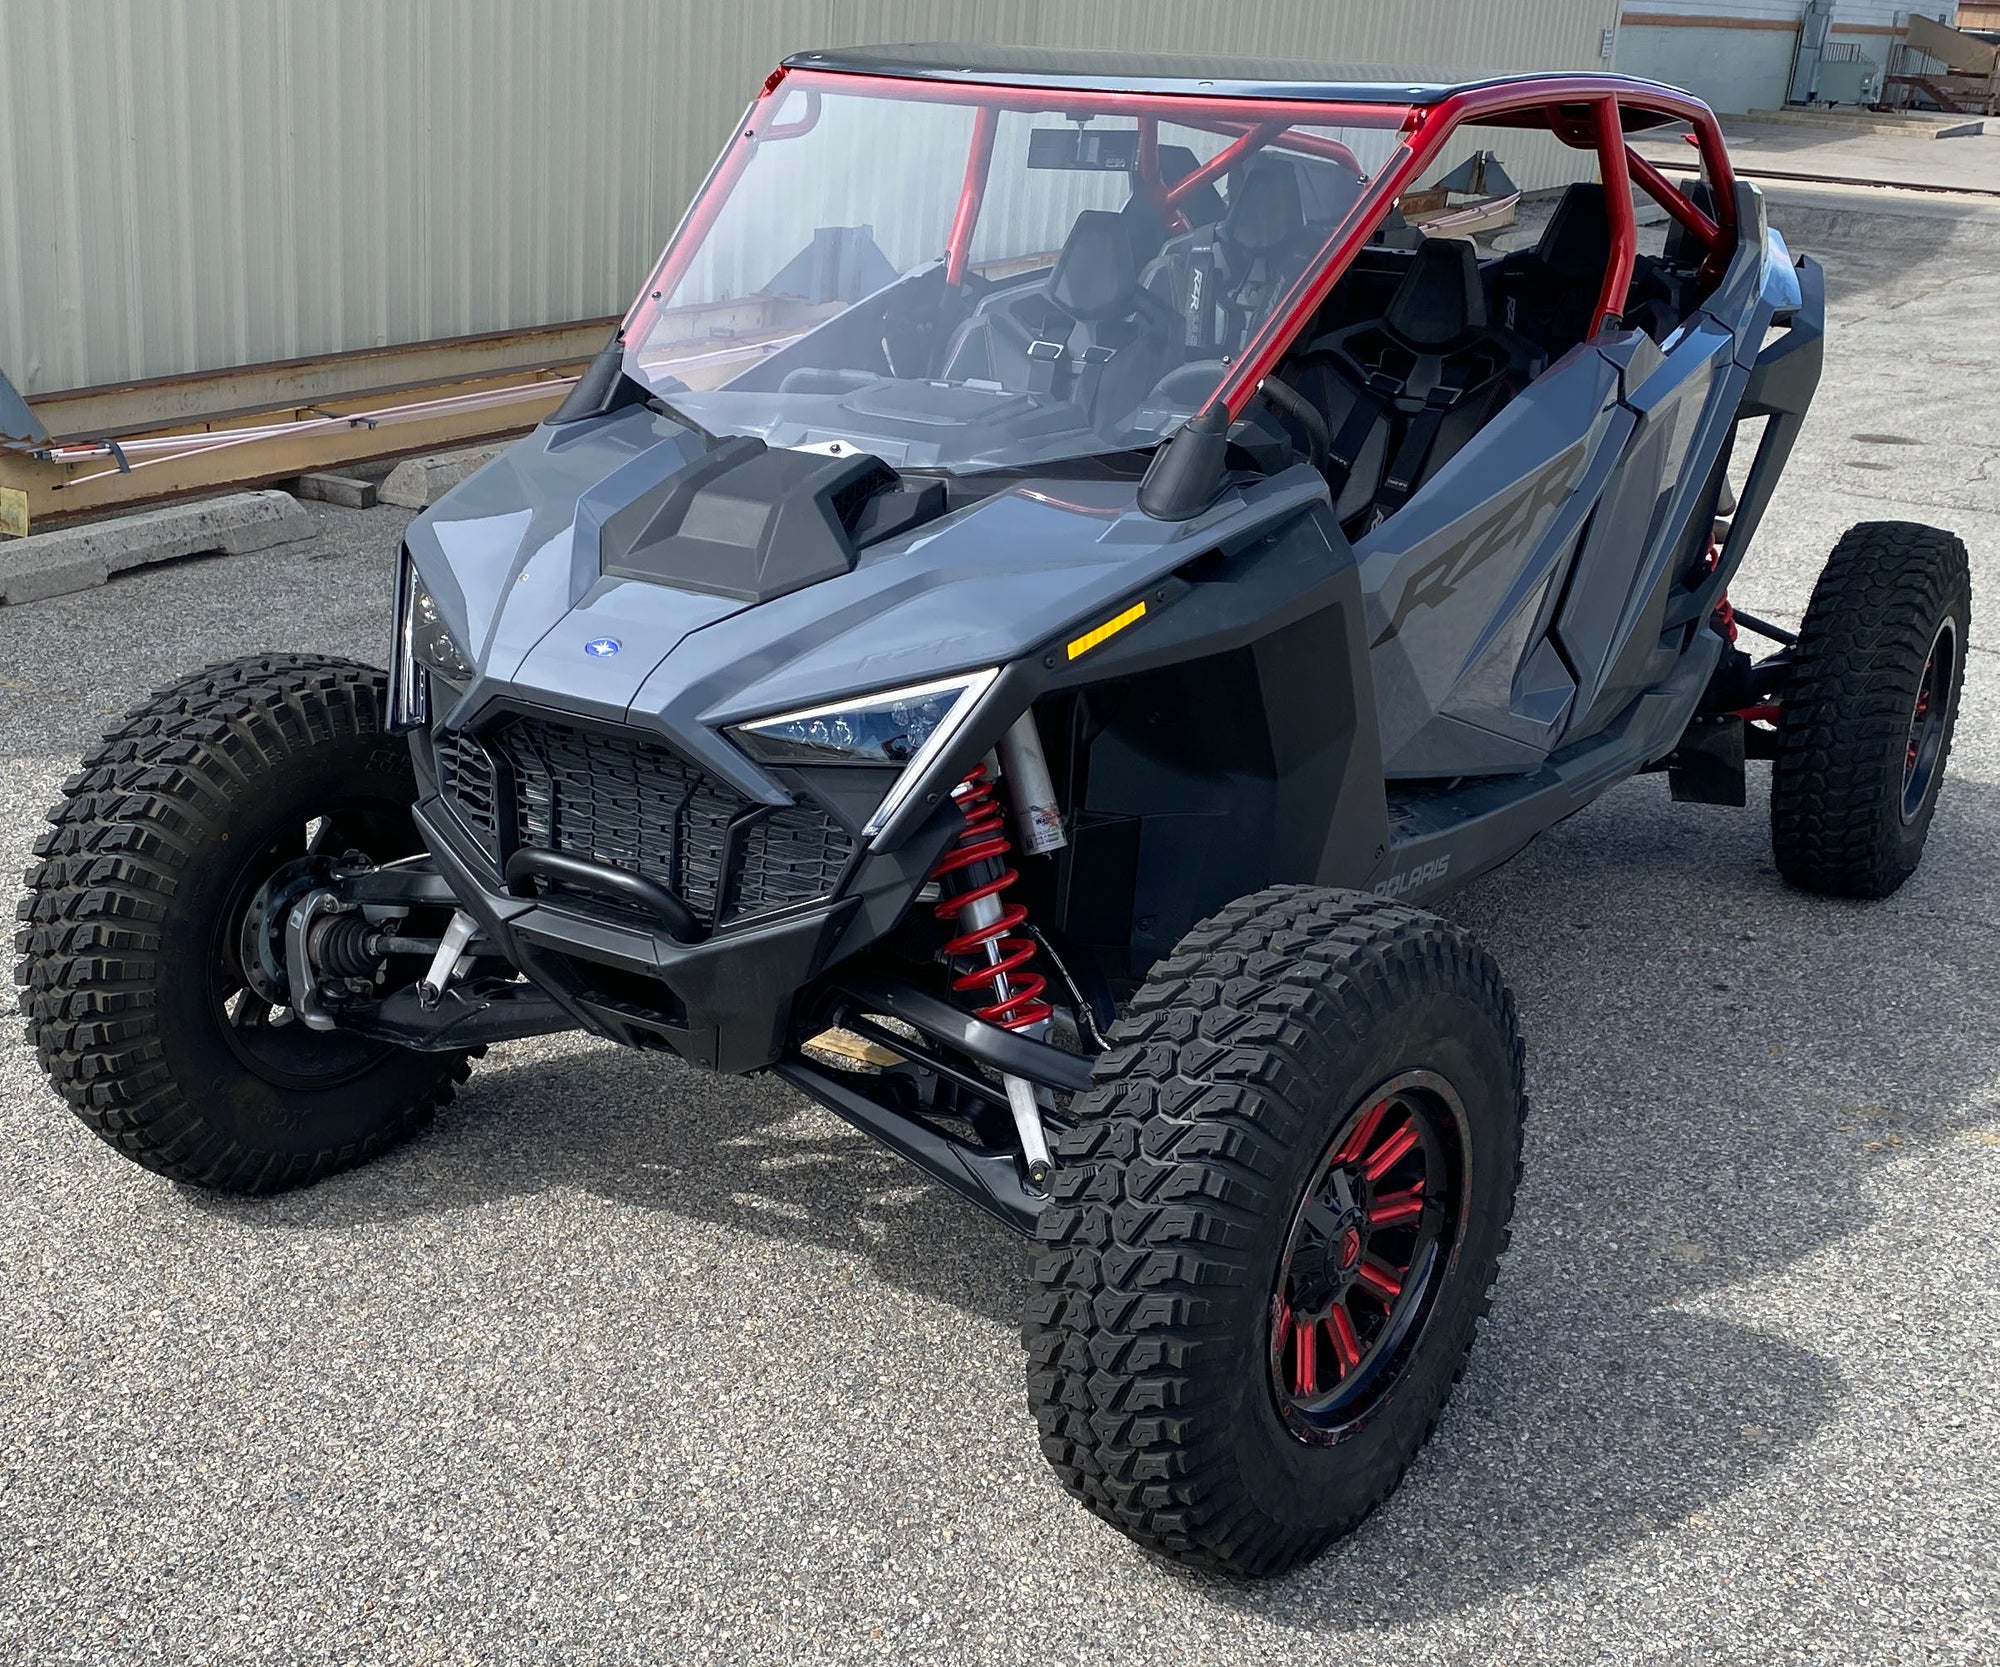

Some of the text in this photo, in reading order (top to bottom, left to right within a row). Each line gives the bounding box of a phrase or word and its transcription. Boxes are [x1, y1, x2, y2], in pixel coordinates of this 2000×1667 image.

[1190, 269, 1203, 311] RZR
[1369, 443, 1587, 649] RZR
[1373, 854, 1451, 898] POLARIS
